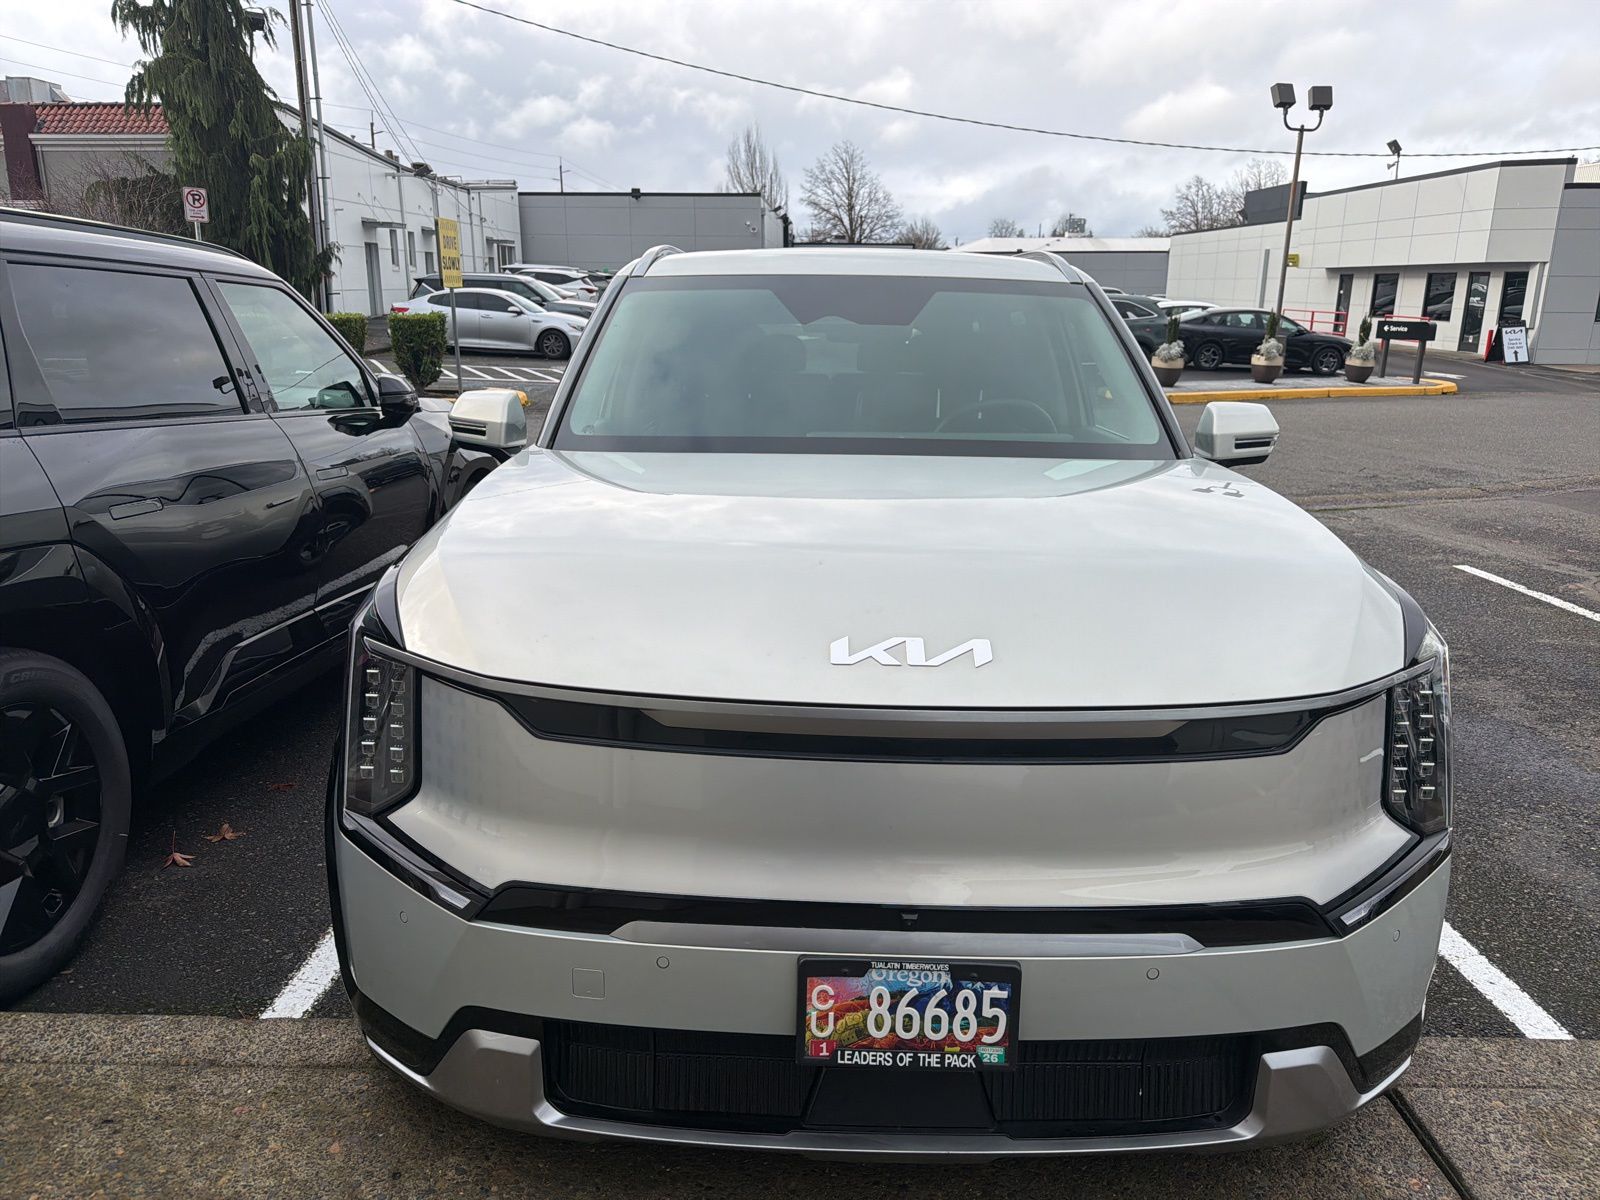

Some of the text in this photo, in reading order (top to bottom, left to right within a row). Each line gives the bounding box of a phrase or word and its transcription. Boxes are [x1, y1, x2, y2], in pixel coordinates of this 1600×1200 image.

[442, 234, 458, 250] DRIVE
[442, 255, 461, 271] SLOWLY
[830, 636, 993, 668] KIA
[871, 961, 950, 971] TUALATIN TIMBERWOLVES
[872, 969, 946, 987] Oregon
[866, 986, 1009, 1043] 86685
[819, 1042, 830, 1056] 1
[837, 1050, 977, 1068] LEADERS OF THE PACK
[982, 1053, 999, 1063] 26
